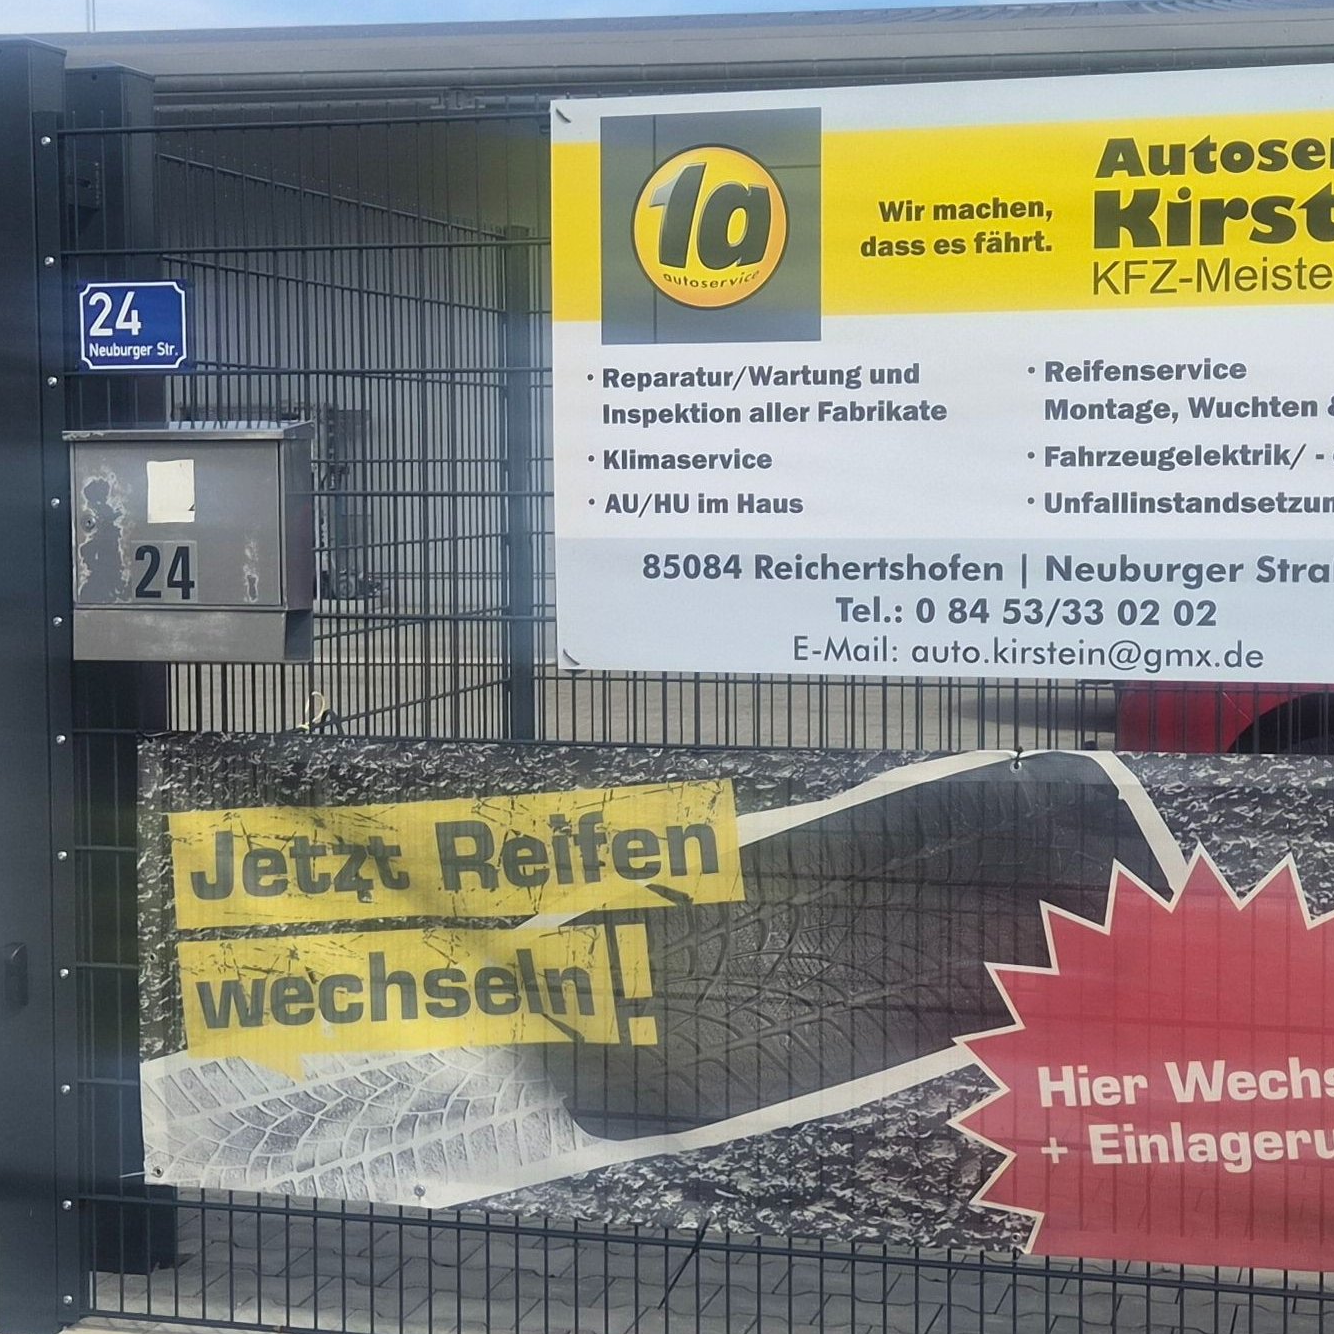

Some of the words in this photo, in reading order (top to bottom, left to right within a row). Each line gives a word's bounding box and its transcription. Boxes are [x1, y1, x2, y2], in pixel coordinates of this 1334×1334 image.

[649, 162, 770, 269] 1a
[879, 200, 924, 222] Wir
[933, 197, 1053, 223] machen,
[860, 234, 925, 257] dass
[934, 238, 966, 254] es
[974, 230, 1052, 253] fährt.
[88, 291, 142, 337] 24
[89, 342, 153, 360] Neuburger
[157, 342, 179, 357] Str.
[603, 364, 862, 392] Reparatur/Wartung
[869, 362, 919, 385] und
[1044, 358, 1247, 382] Reifenservice
[603, 403, 741, 428] Inspektion
[749, 401, 809, 423] aller
[818, 399, 947, 423] Fabrikate
[1044, 398, 1179, 424] Montage,
[1187, 395, 1317, 418] Wuchten
[603, 449, 772, 470] Klimaservice
[1044, 443, 1307, 471] Fahrzeugelektrik/
[605, 493, 689, 518] AU/HU
[698, 494, 728, 514] im
[737, 493, 803, 514] Haus
[134, 545, 195, 600] 24
[642, 554, 742, 580] 85084
[755, 553, 1003, 582] Reichertshofen
[1046, 554, 1244, 590] Neuburger
[836, 597, 902, 624] Tel.:
[916, 597, 935, 624] 0
[948, 597, 989, 624] 84
[1002, 597, 1104, 628] 53/33
[1117, 599, 1160, 626] 02
[1173, 599, 1217, 627] 02
[794, 635, 898, 663] E-Mail:
[911, 637, 1264, 674] auto.kirstein@gmx.de
[190, 830, 410, 902] Jetzt
[435, 812, 720, 892] Reifen
[1037, 1065, 1148, 1108] Hier
[1041, 1138, 1068, 1164] +
